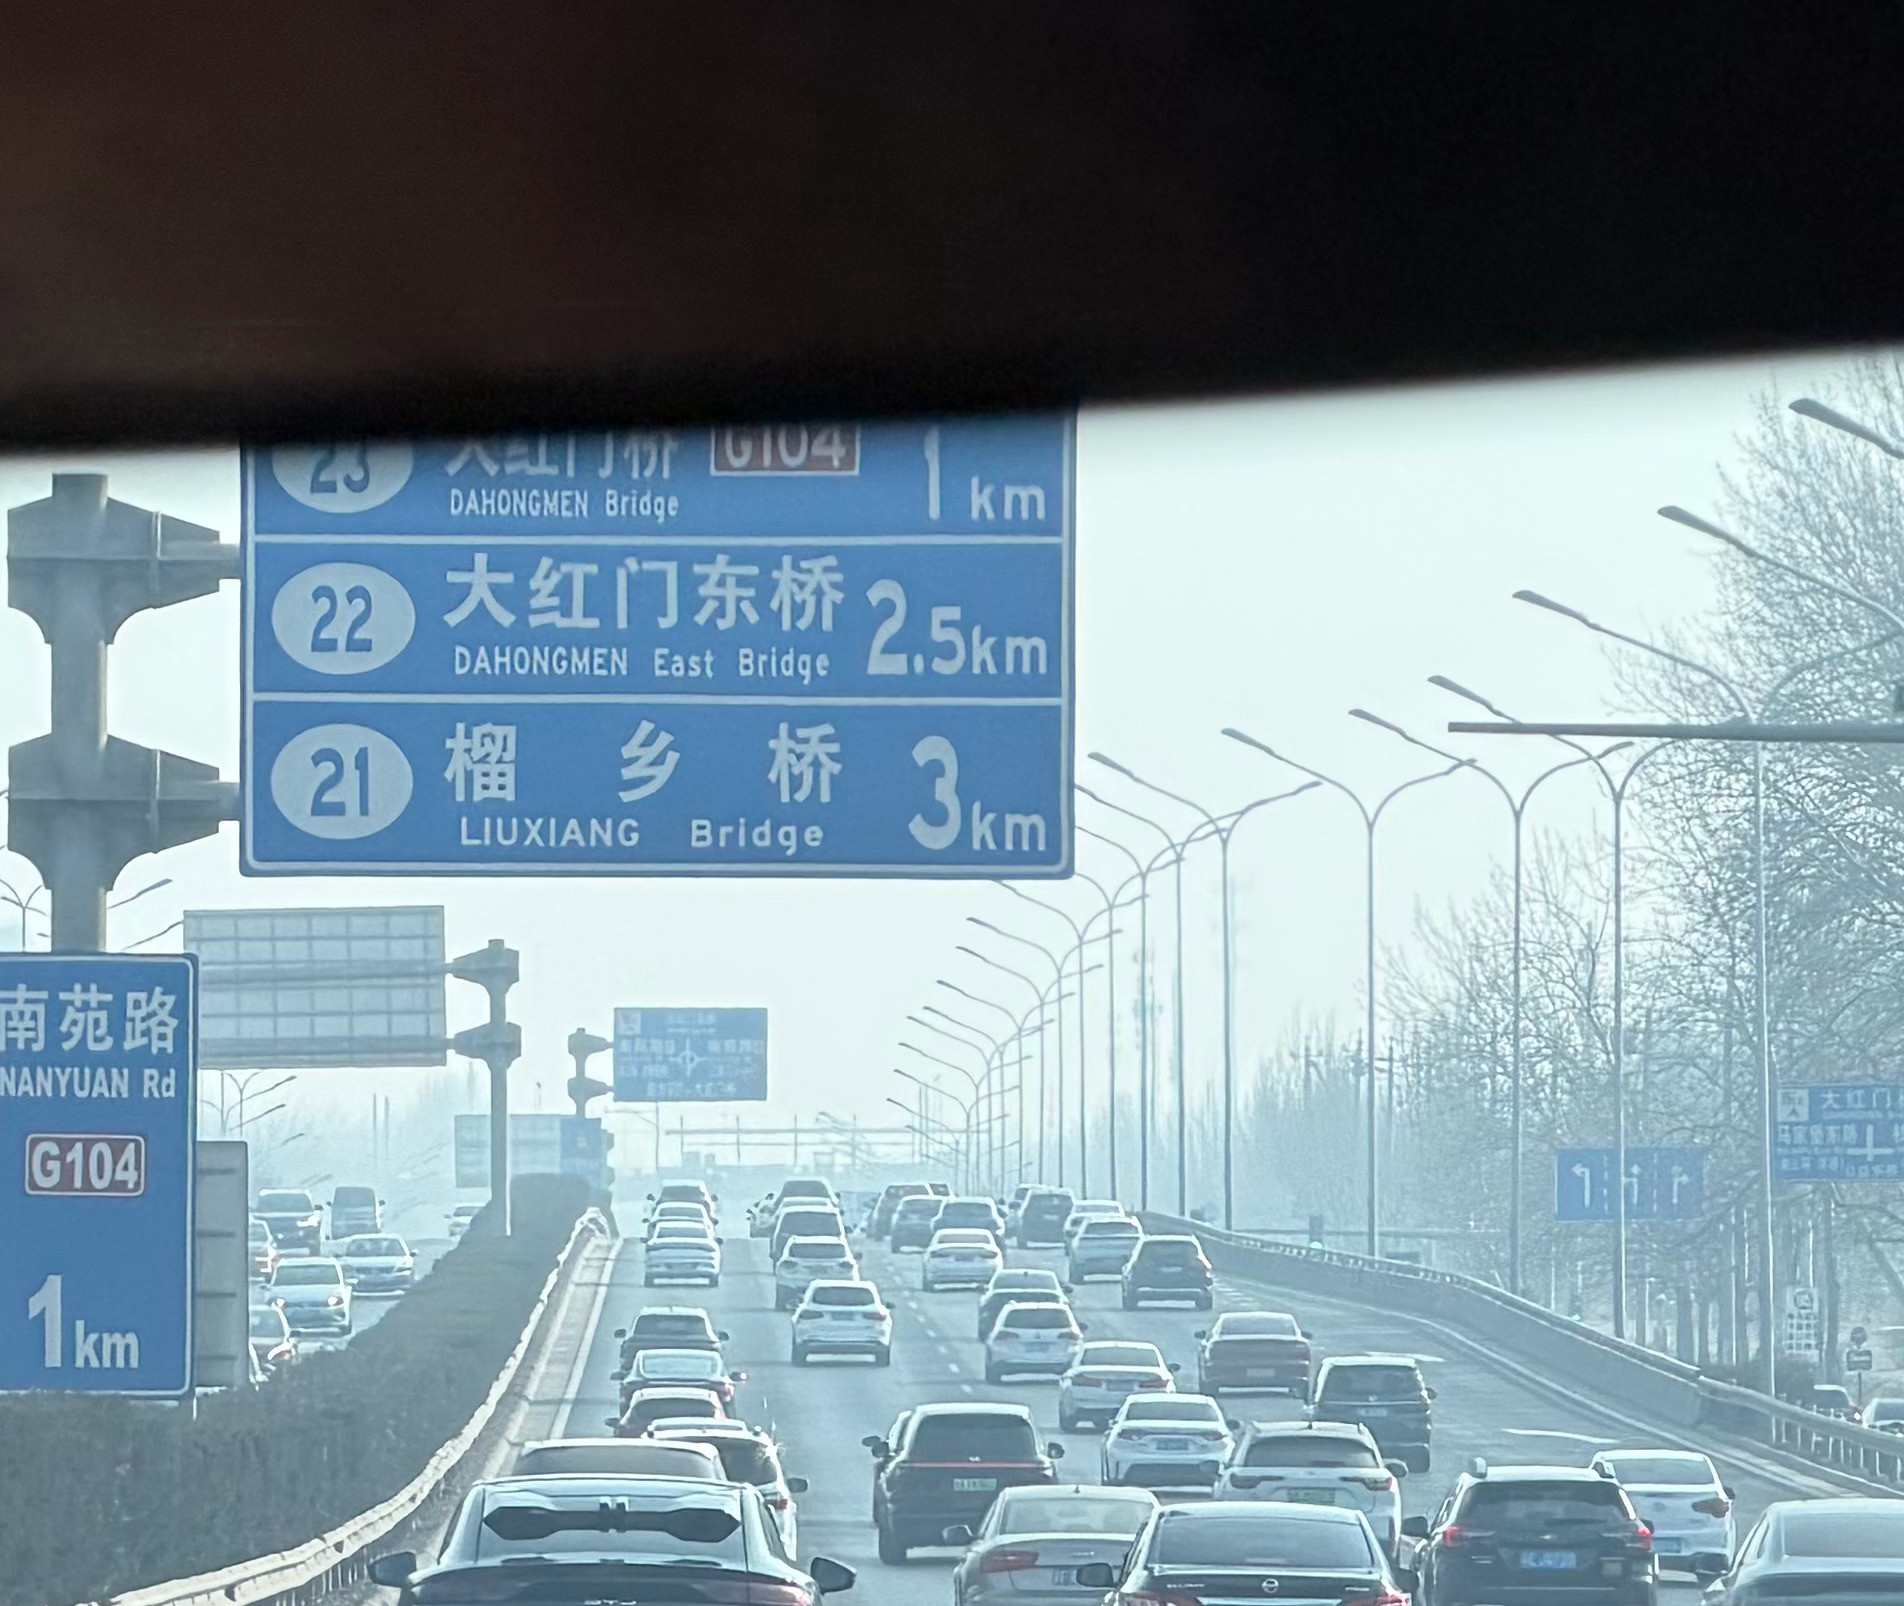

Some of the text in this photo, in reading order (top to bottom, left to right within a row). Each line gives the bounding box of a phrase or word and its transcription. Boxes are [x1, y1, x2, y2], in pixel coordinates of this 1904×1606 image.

[309, 434, 371, 494] 23
[725, 424, 848, 467] G104
[451, 489, 678, 523] DAHONGMEN Bridge
[971, 477, 1045, 520] km
[443, 553, 844, 631] 大红门东桥
[311, 585, 372, 653] 22
[456, 646, 829, 682] DAHONGMEN East Bridge
[311, 747, 369, 816] 21
[444, 720, 841, 802] 榴乡桥
[461, 816, 823, 856] LIUXIANG Bridge
[0, 1066, 175, 1098] NANYUAN Rd
[32, 1142, 137, 1189] G104
